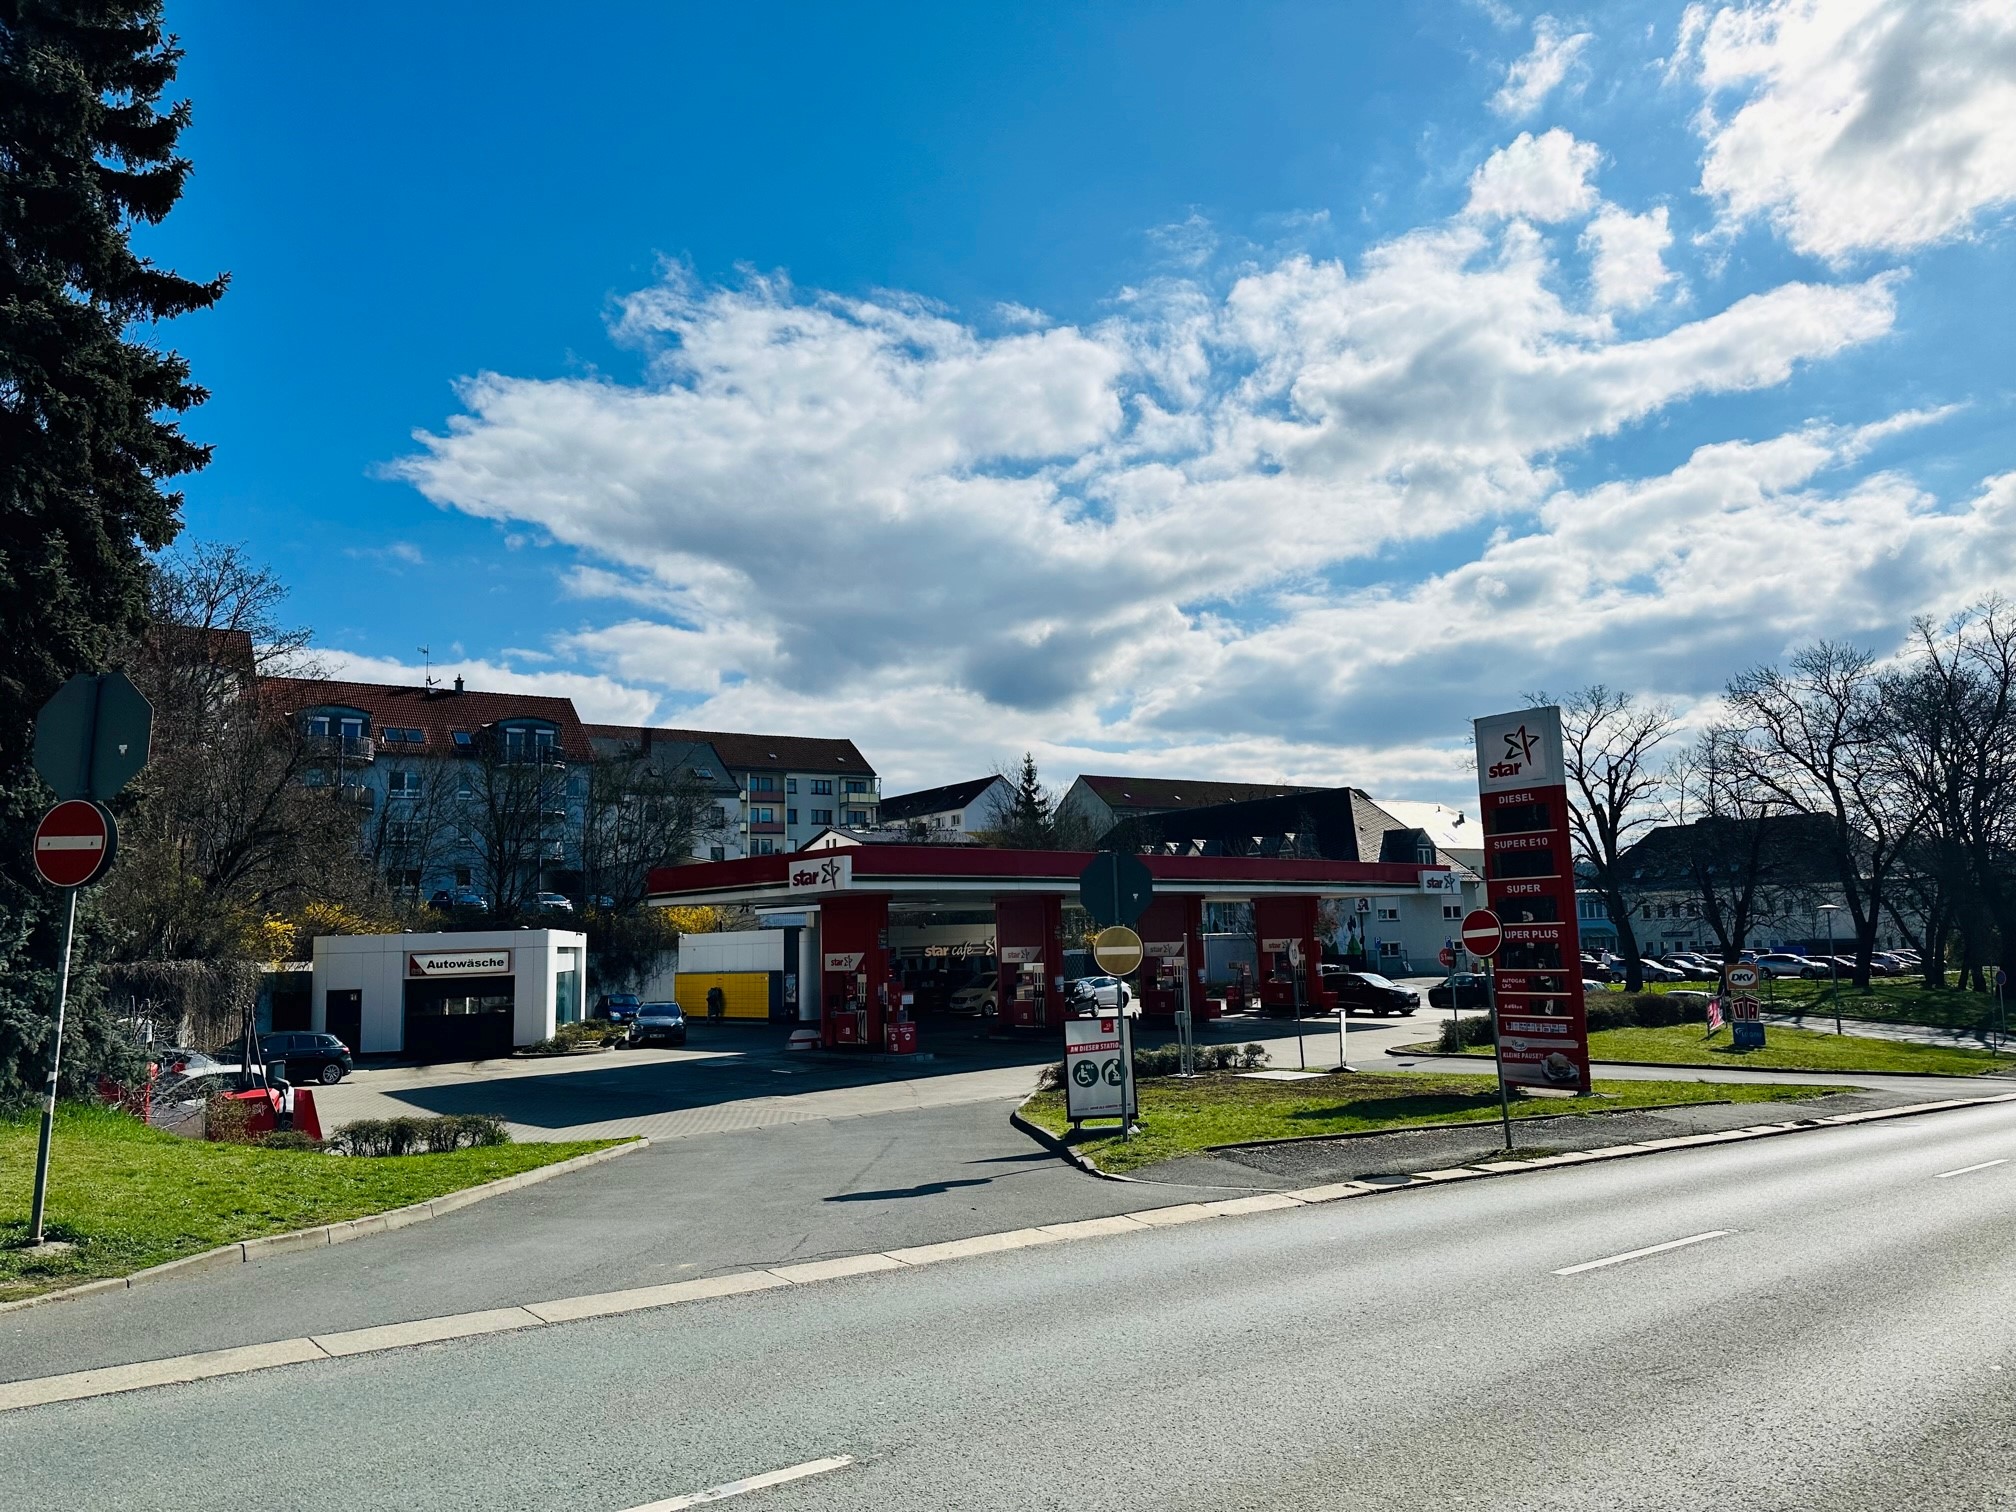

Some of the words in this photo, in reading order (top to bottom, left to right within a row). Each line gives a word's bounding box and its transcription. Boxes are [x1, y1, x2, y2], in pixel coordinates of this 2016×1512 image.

[1489, 761, 1522, 778] star
[1498, 792, 1535, 804] DIESEL
[1494, 839, 1527, 849] SUPER
[1529, 837, 1548, 846] E10
[793, 869, 819, 886] star
[1426, 877, 1443, 888] star
[1506, 884, 1541, 894] SUPER
[1504, 930, 1530, 939] UPER
[1532, 929, 1559, 939] PLUS
[924, 944, 949, 957] star
[951, 941, 974, 961] café
[1007, 951, 1020, 959] star
[426, 958, 504, 969] Autowäsche
[830, 958, 843, 966] star
[1731, 973, 1754, 981] DKV
[1079, 1043, 1099, 1052] DIESER
[1100, 1042, 1119, 1050] STATIO
